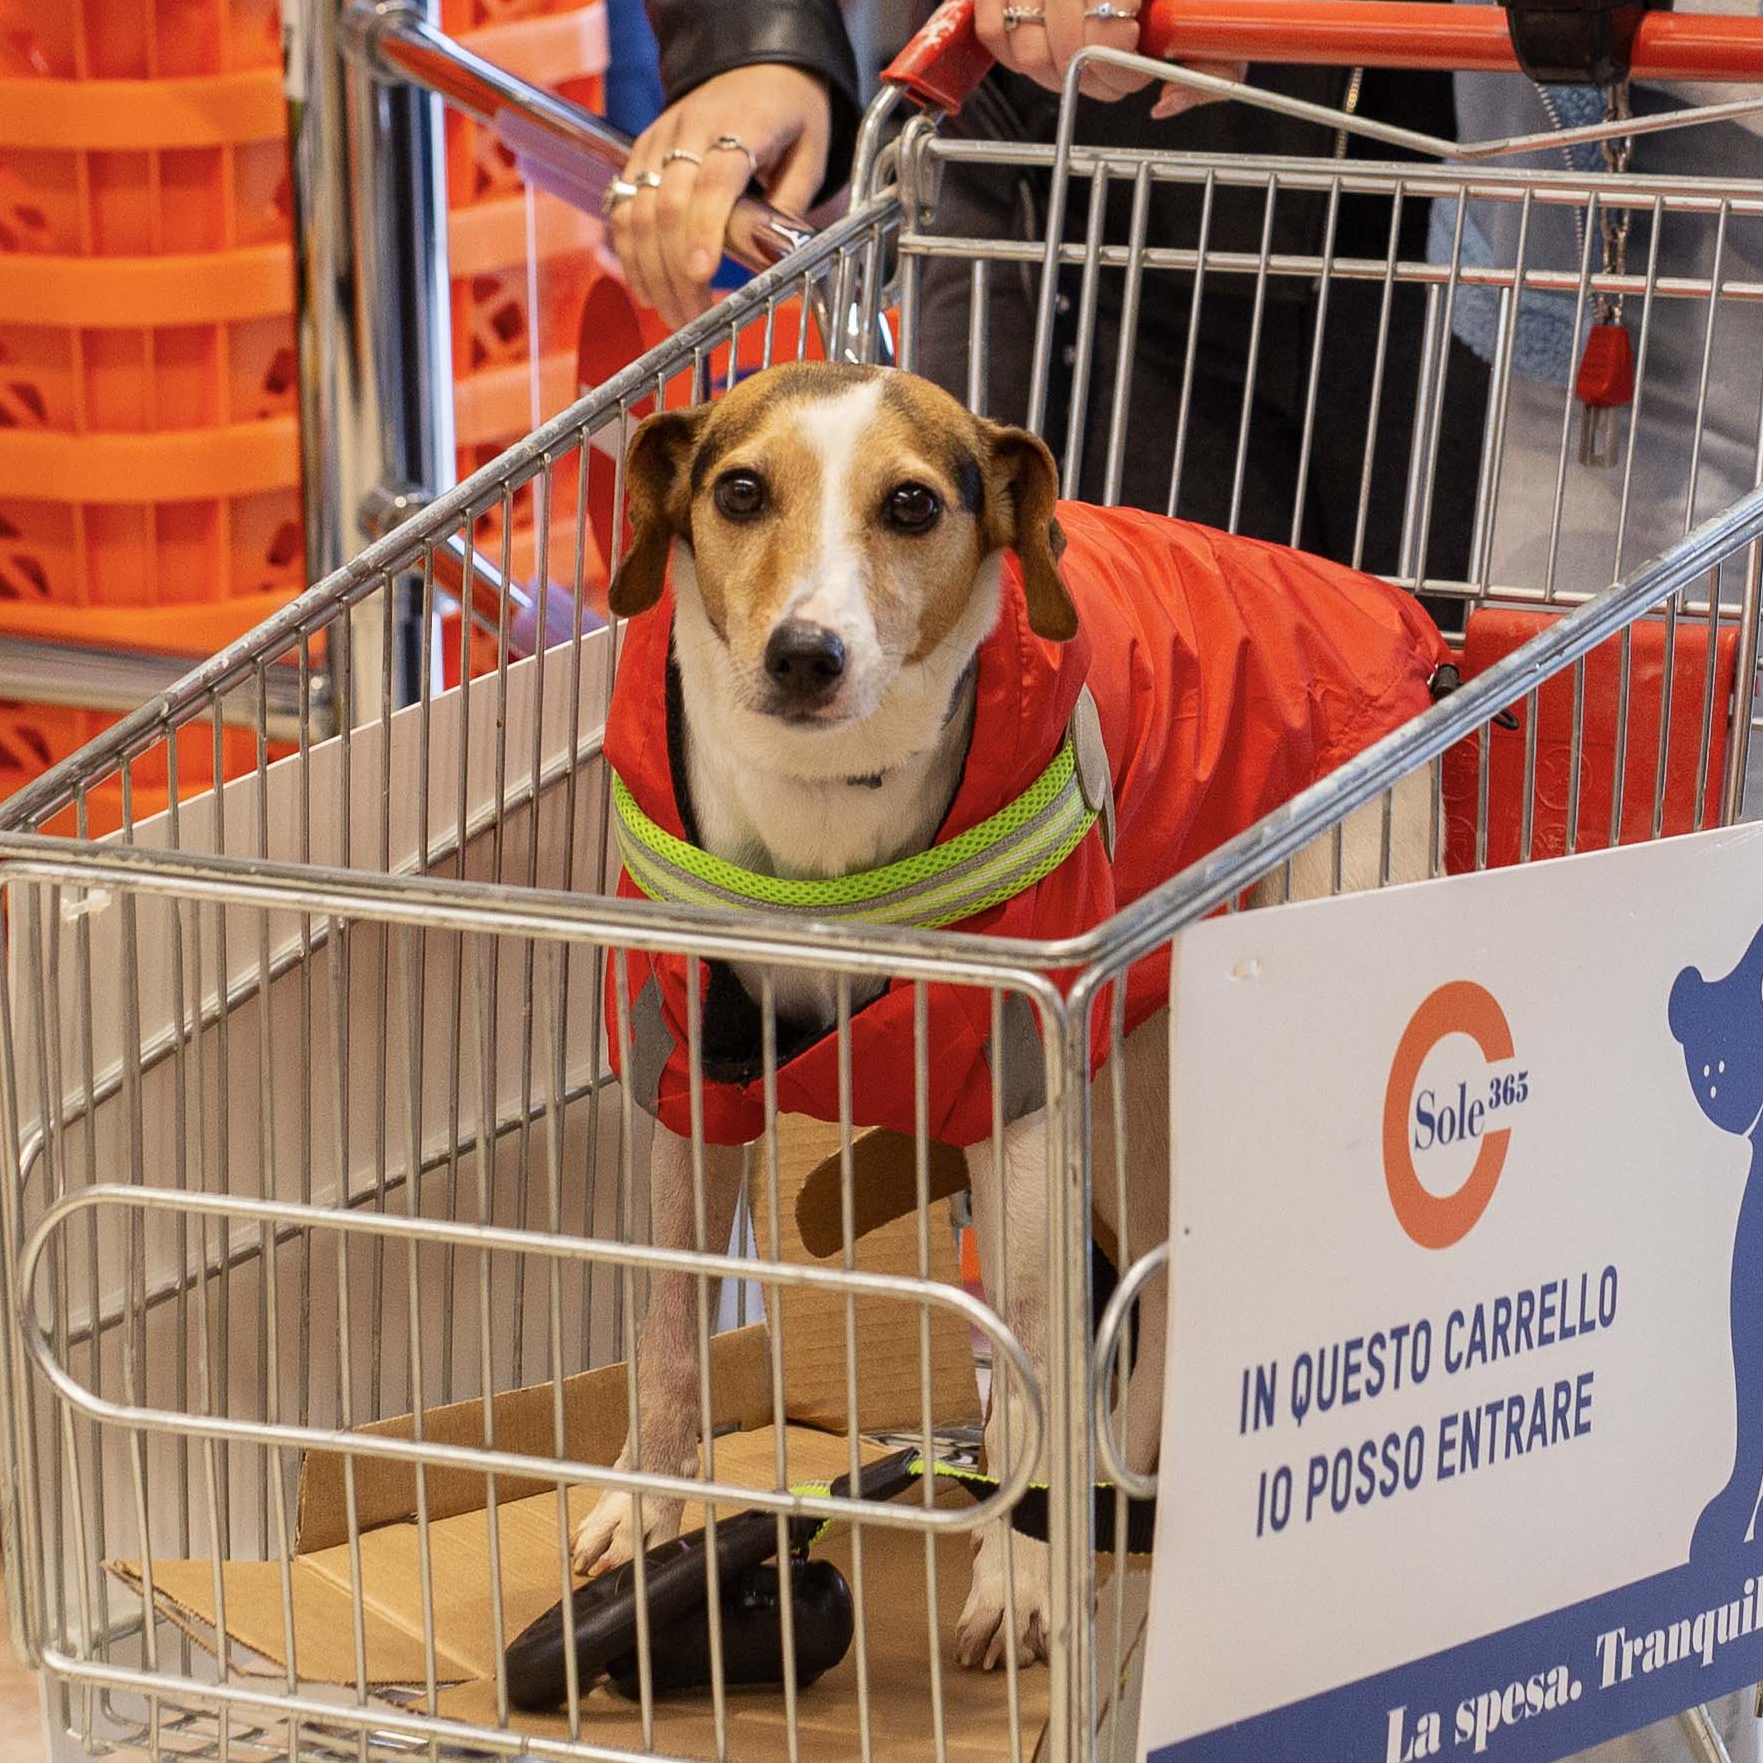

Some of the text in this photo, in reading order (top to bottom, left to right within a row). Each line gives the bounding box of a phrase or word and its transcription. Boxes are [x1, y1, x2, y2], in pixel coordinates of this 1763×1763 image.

[1413, 1070, 1530, 1152] Sole 365
[1240, 1264, 1619, 1435] IN QUESTO CARRELLO
[1256, 1370, 1596, 1538] IO POSSO ENTRARE
[1385, 1703, 1442, 1763] La
[1454, 1663, 1583, 1750] spesa.
